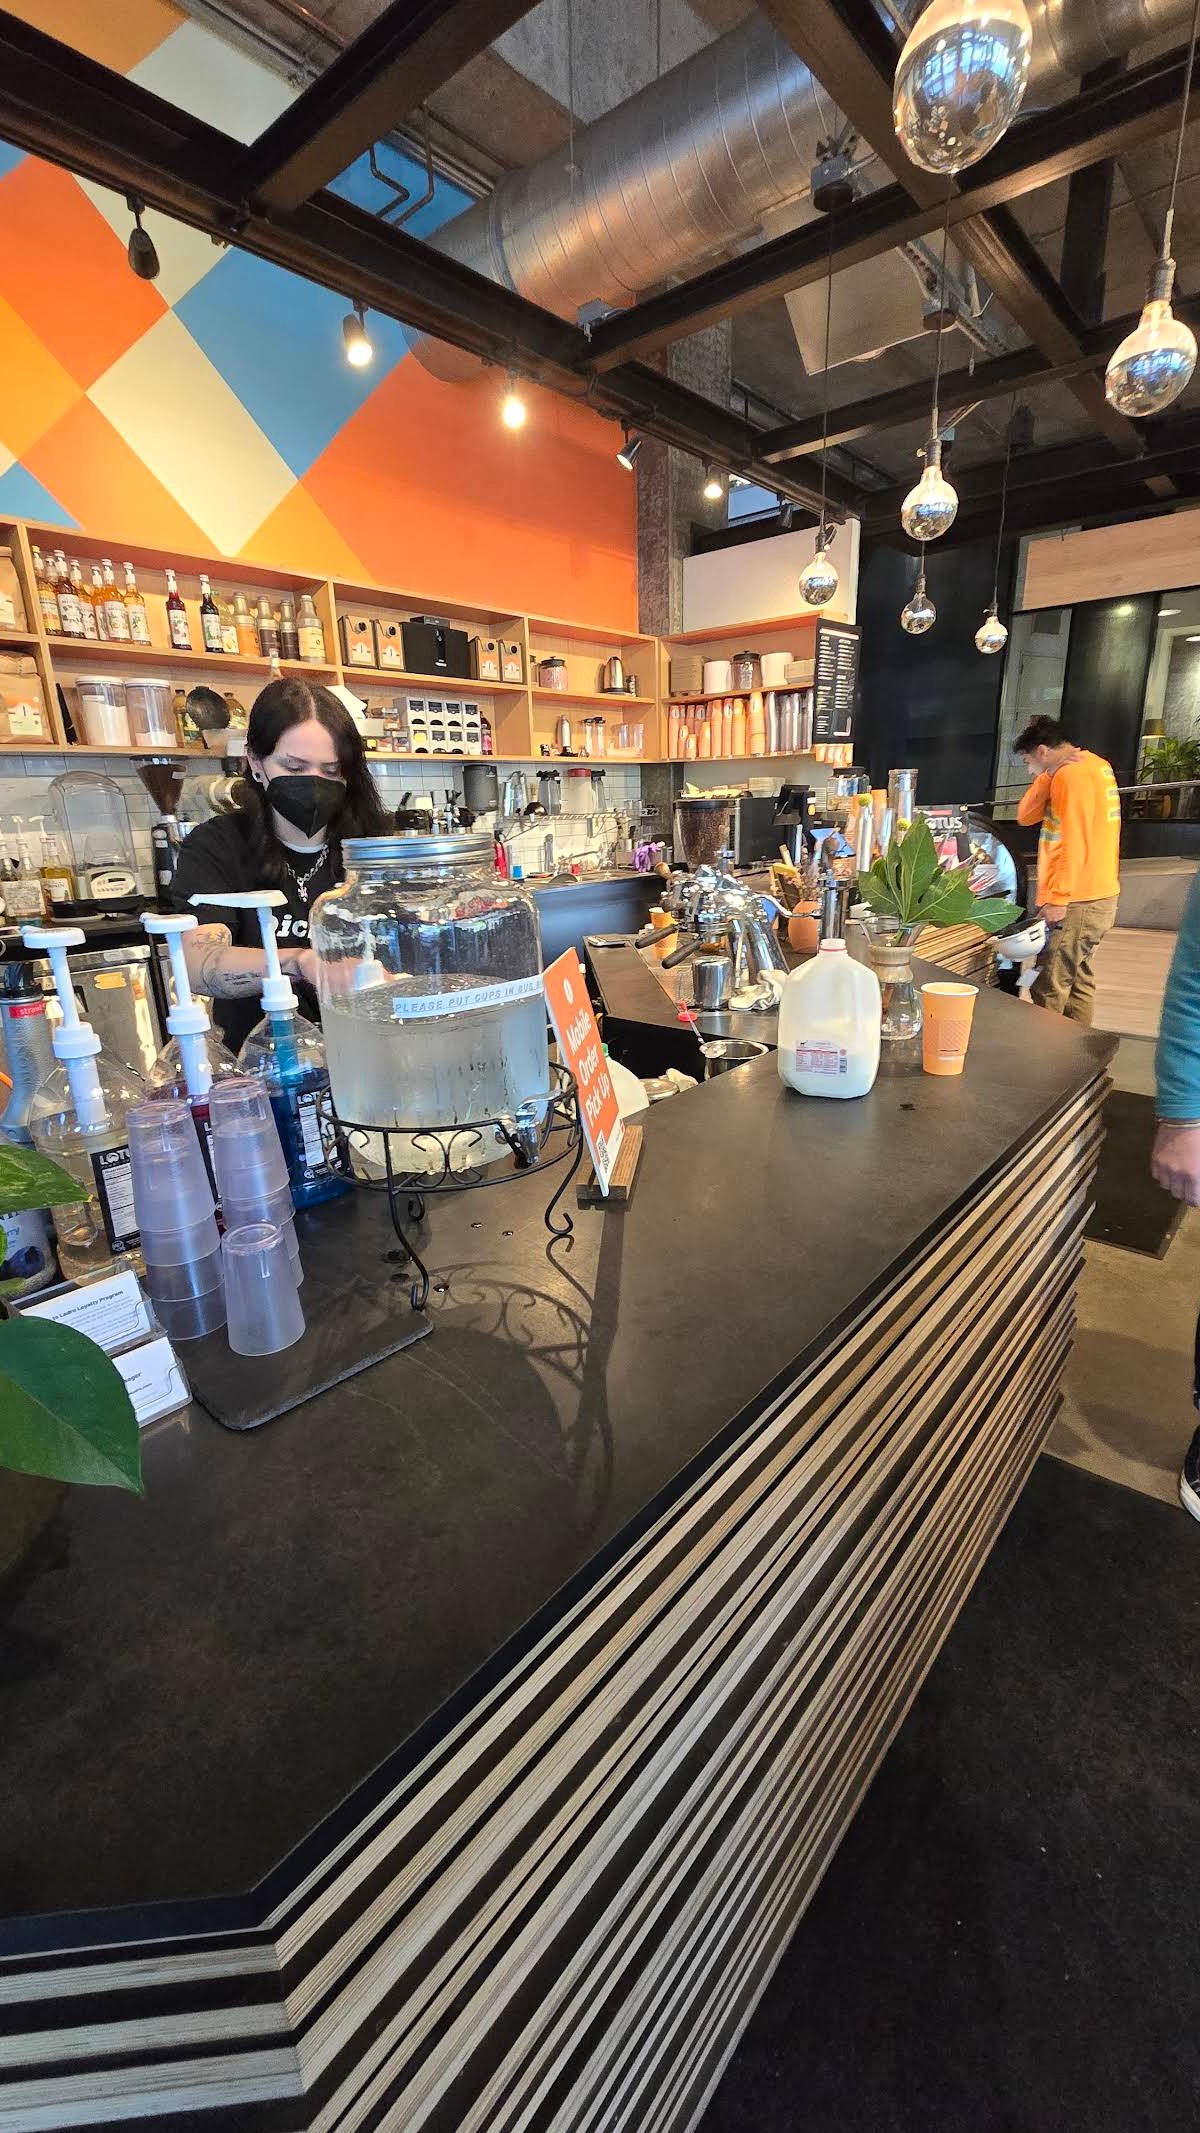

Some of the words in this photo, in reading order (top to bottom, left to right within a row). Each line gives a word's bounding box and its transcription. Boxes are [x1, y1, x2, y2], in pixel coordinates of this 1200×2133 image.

[924, 816, 963, 829] OTUS
[272, 914, 313, 938] ic
[394, 1000, 443, 1013] PLEASE
[448, 995, 471, 1008] PUT
[474, 989, 501, 1004] CUPS
[504, 988, 515, 997] IN
[565, 1009, 592, 1057] Mobile
[578, 1043, 600, 1087] Order
[585, 1091, 602, 1129] Pick
[599, 1073, 611, 1099] Up
[77, 1299, 99, 1311] Loyalty
[99, 1290, 124, 1303] Program
